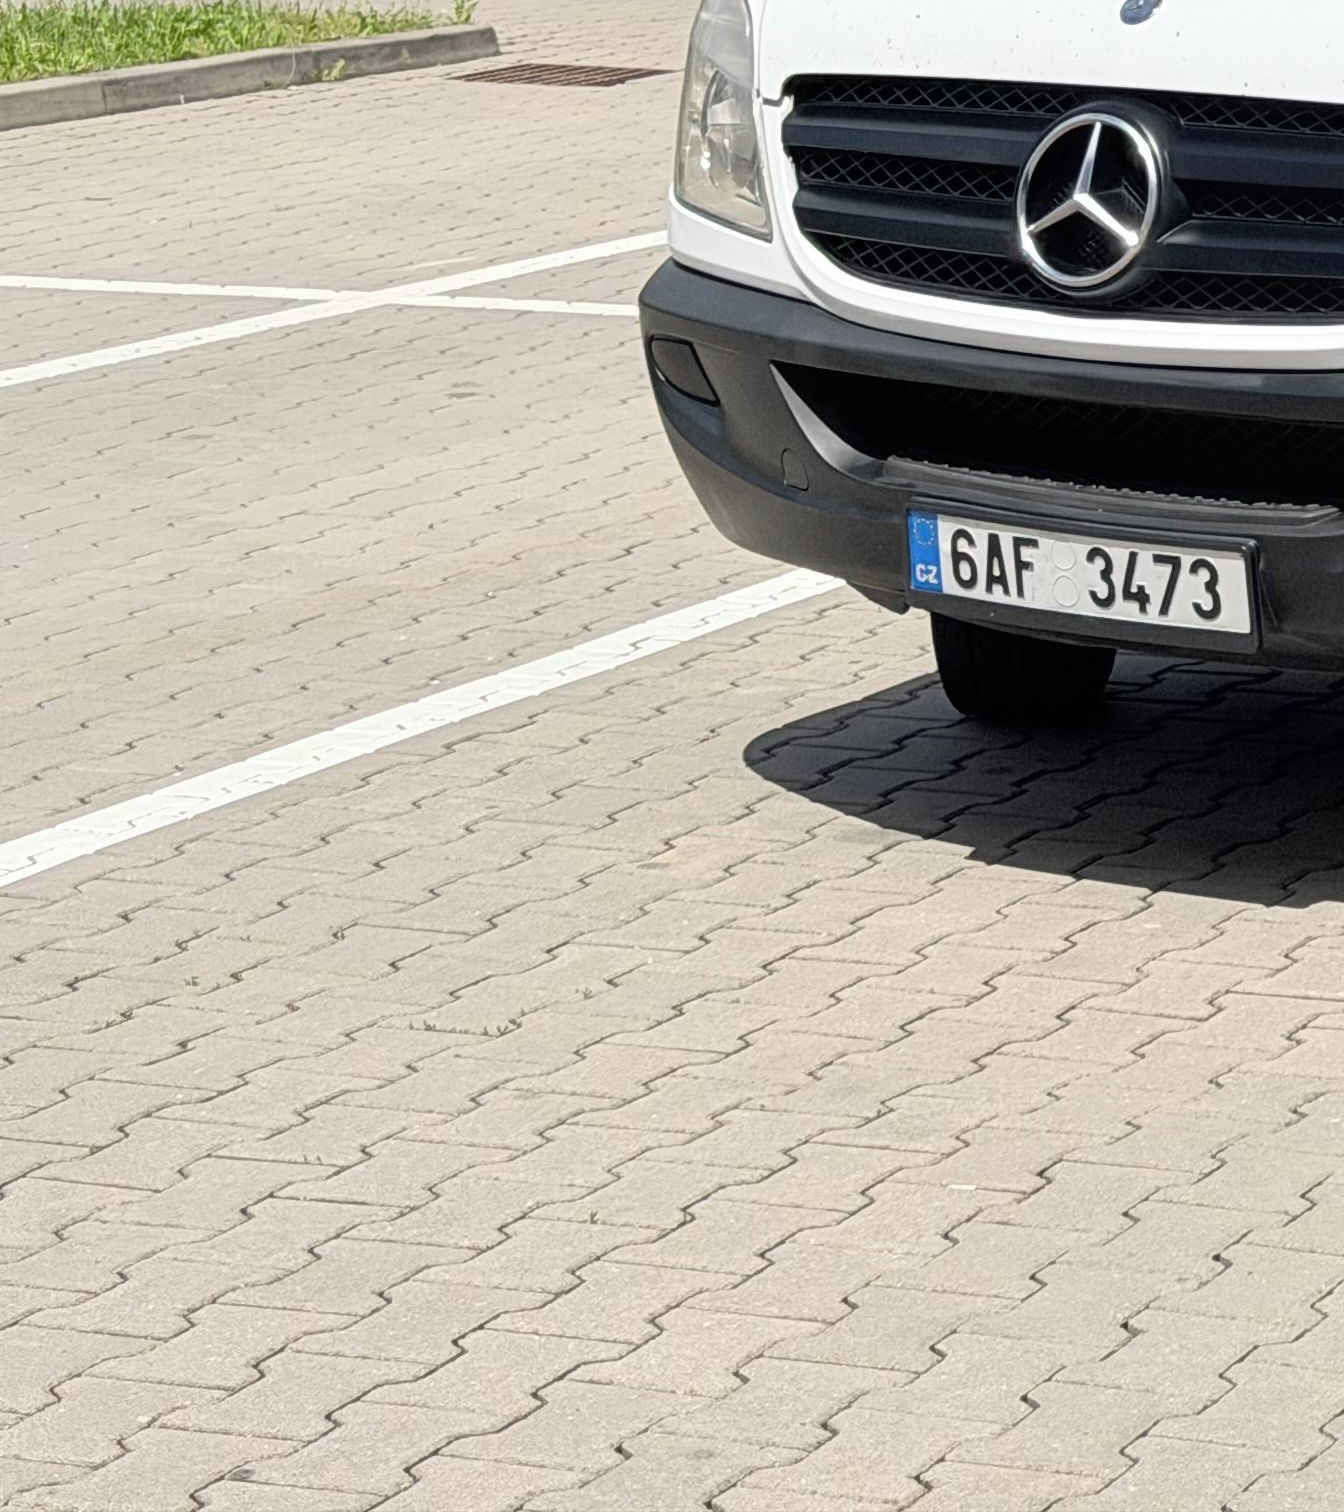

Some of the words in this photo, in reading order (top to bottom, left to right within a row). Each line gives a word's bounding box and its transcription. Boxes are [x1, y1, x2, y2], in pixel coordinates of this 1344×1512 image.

[915, 563, 939, 585] CZ
[950, 528, 1040, 600] 6AF
[1086, 546, 1223, 620] 3473
